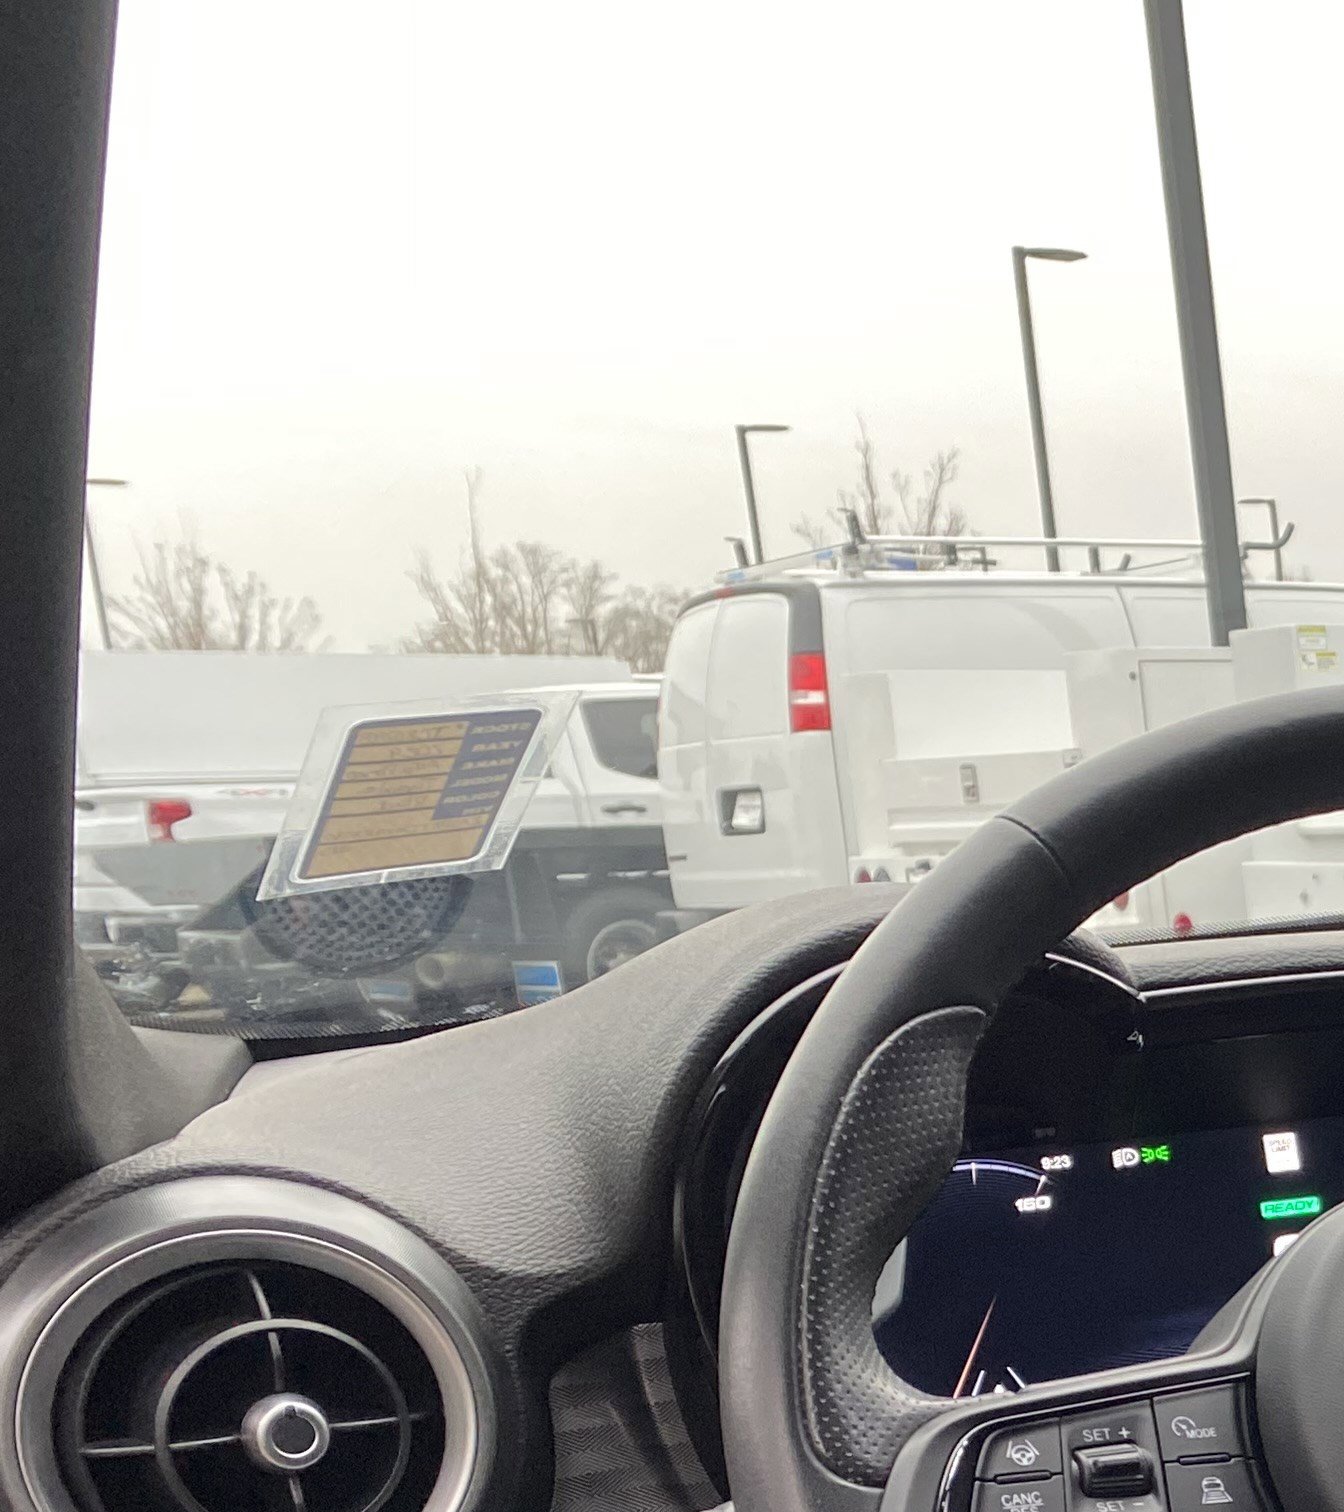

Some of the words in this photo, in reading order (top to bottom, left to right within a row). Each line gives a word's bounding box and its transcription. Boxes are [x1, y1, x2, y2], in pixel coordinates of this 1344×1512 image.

[1040, 1154, 1073, 1170] 9:23
[1264, 1200, 1314, 1213] READY
[1083, 1428, 1111, 1442] SET
[1185, 1427, 1218, 1439] MODE
[1001, 1491, 1042, 1506] CANC
[1096, 1501, 1125, 1512] SET
